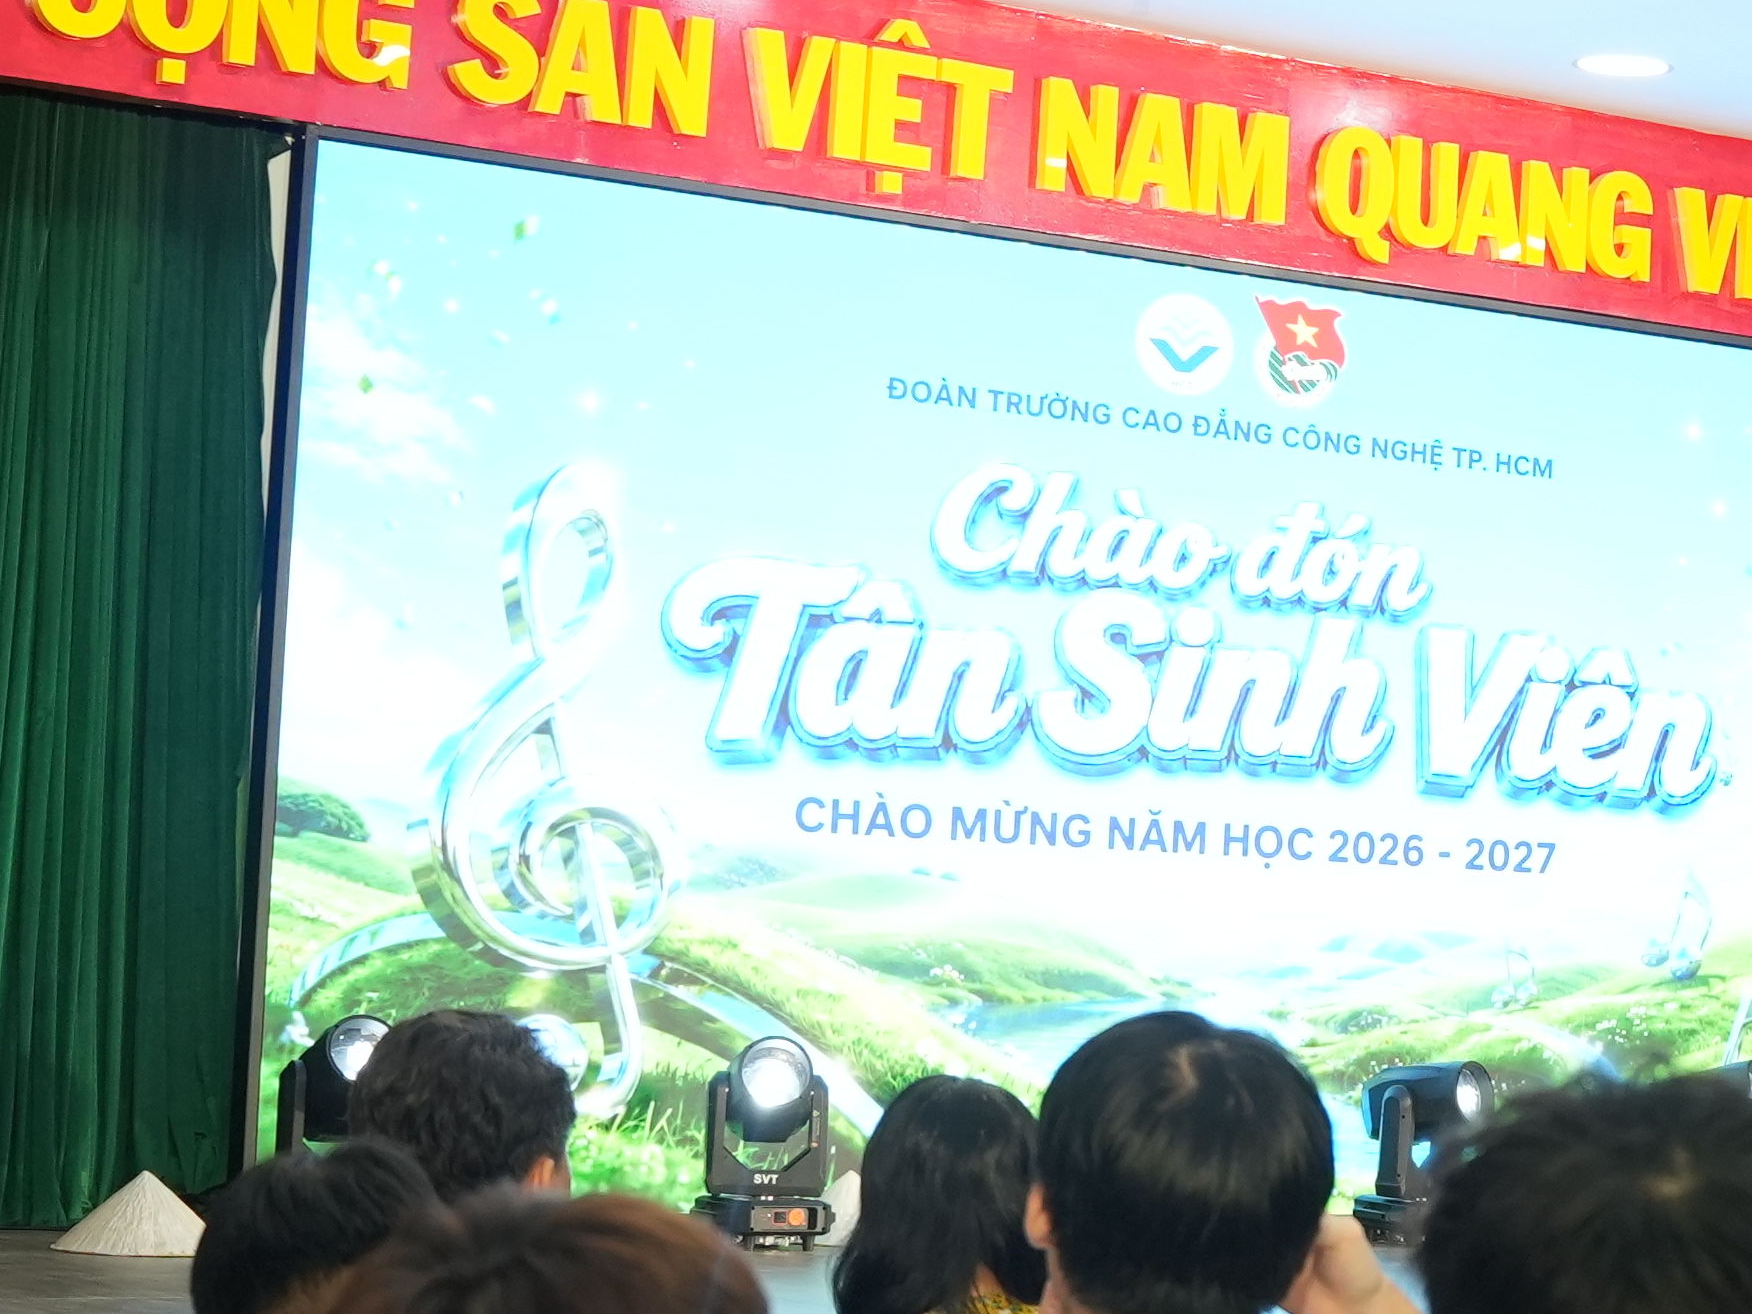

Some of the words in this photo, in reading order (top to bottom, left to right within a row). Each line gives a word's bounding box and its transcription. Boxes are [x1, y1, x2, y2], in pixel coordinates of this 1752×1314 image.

[743, 19, 1014, 194] VIỆT
[1037, 76, 1288, 225] NAM
[1312, 125, 1654, 282] QUANG
[886, 376, 976, 409] ĐOÀN
[988, 389, 1111, 425] TRƯỜNG
[1122, 407, 1183, 435] CAO
[1192, 408, 1272, 446] ĐẲNG
[1283, 423, 1361, 456] CÔNG
[1371, 437, 1443, 471] NGHỆ
[1453, 446, 1488, 471] TP.
[1495, 454, 1554, 479] HCM
[932, 463, 1224, 597] Chào
[1232, 499, 1432, 621] đón
[662, 557, 1029, 766] Tân
[1034, 588, 1395, 775] Sinh
[1413, 622, 1718, 813] Viên
[795, 794, 934, 841] CHÀO
[949, 791, 1090, 850] MỪNG
[1107, 806, 1207, 857] NĂM
[1223, 822, 1313, 868] HỌC
[1329, 831, 1423, 869] 2026
[1463, 839, 1556, 875] 2027
[753, 1173, 779, 1185] SVT
